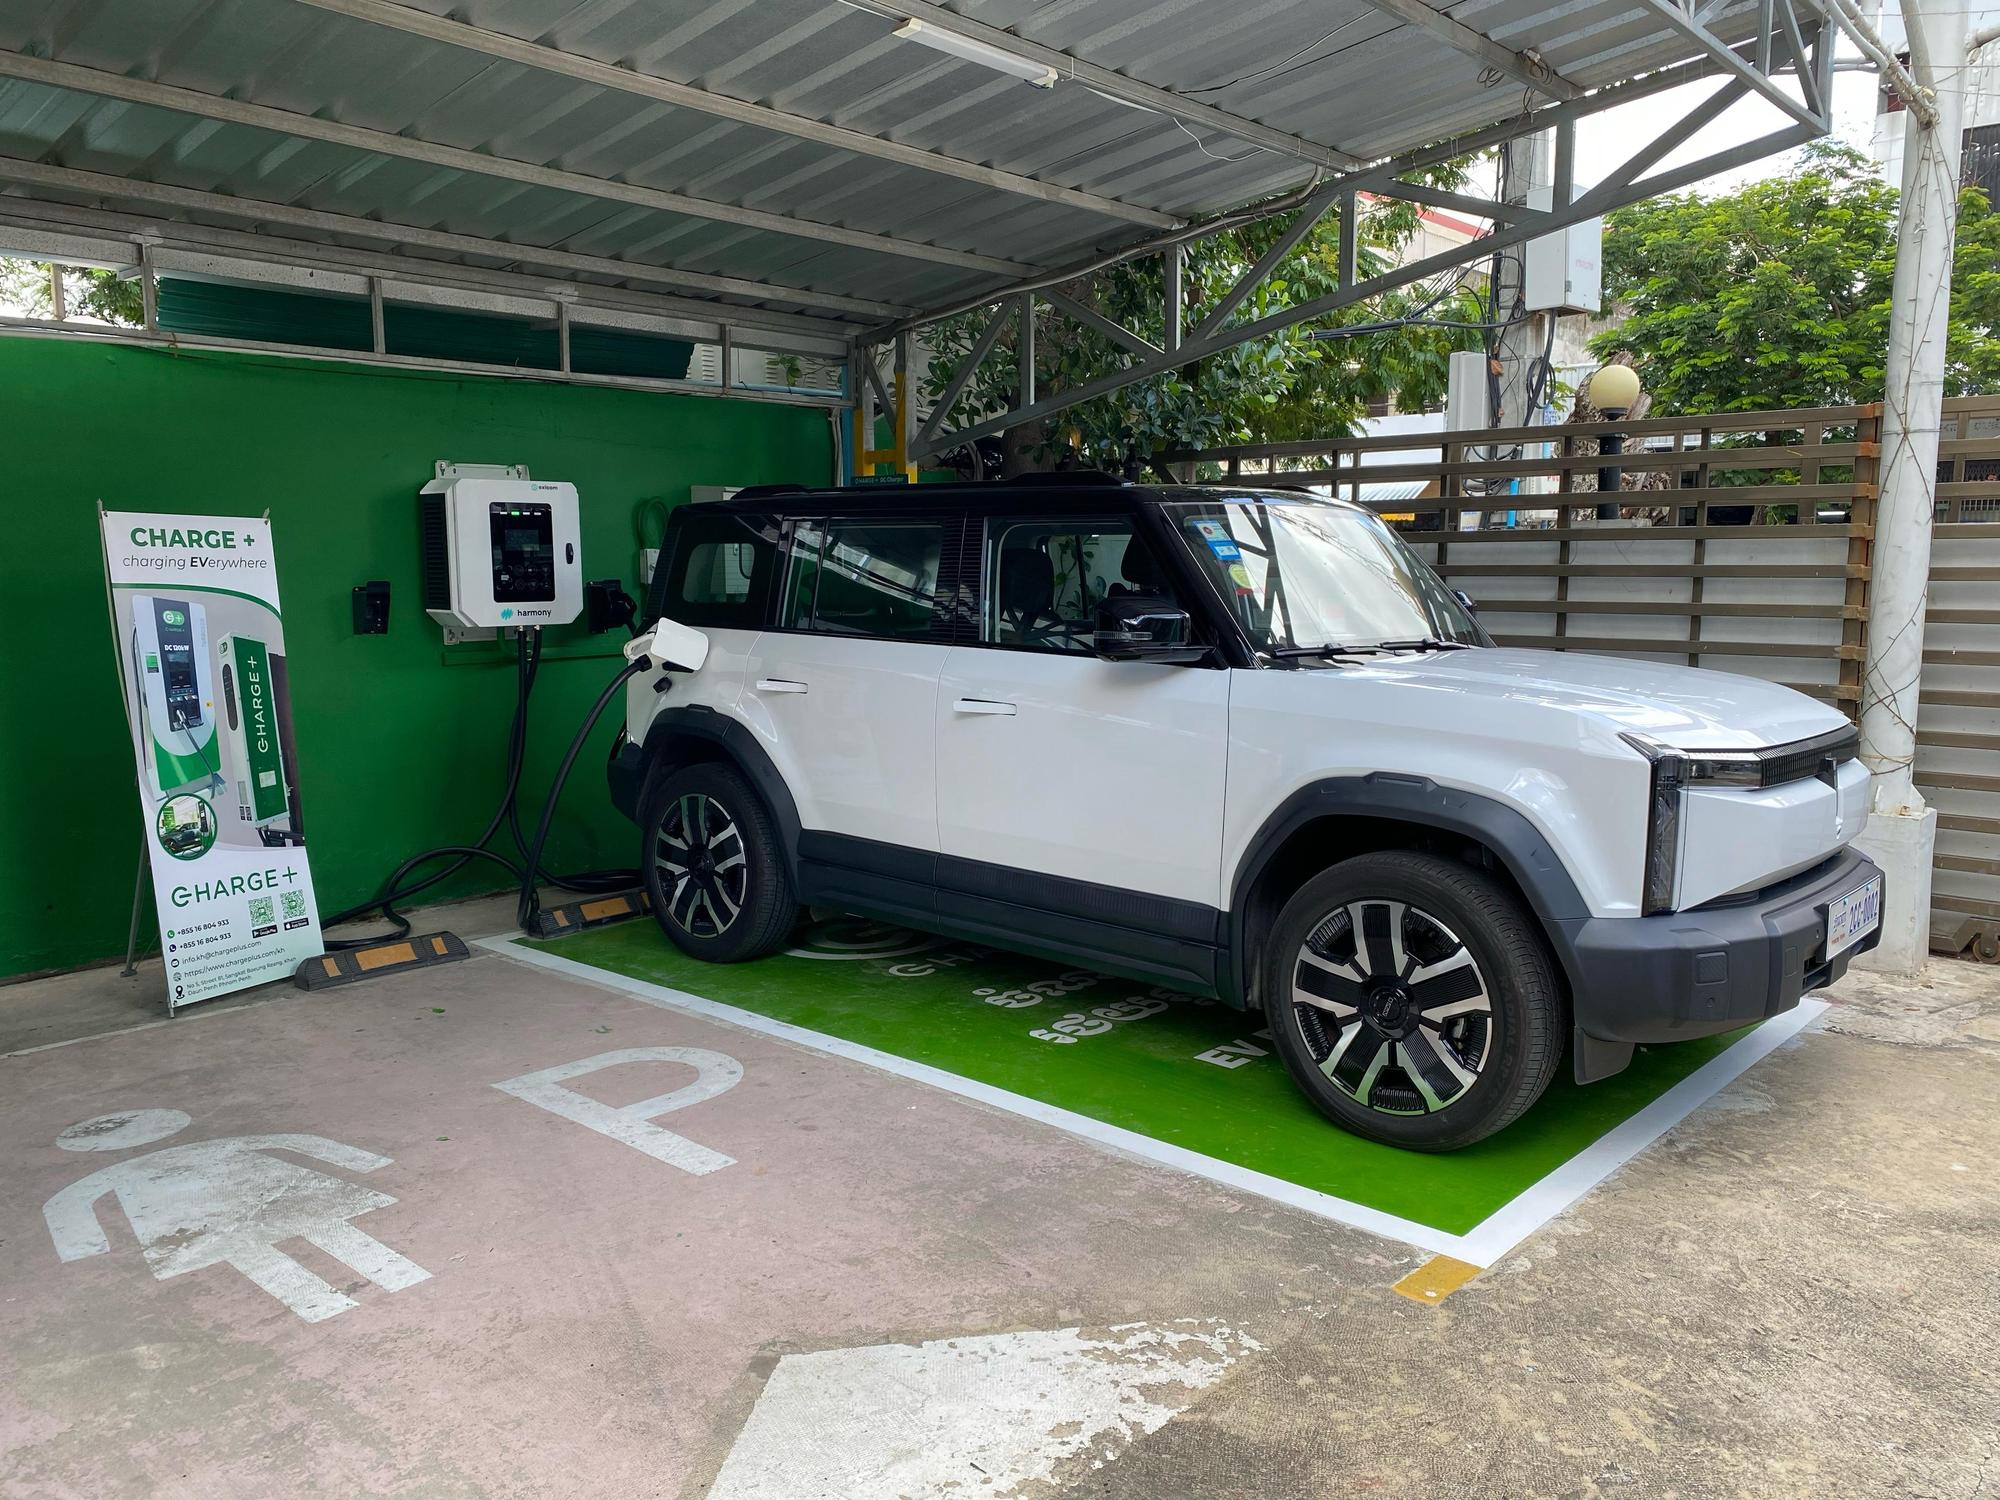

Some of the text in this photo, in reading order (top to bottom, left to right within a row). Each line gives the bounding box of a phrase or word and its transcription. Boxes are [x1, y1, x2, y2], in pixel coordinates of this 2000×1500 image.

[130, 527, 237, 549] CHARGE
[122, 554, 268, 571] charging EVerywhere
[517, 608, 552, 617] harmony
[177, 926, 194, 935] +855
[203, 922, 217, 930] 804
[217, 919, 230, 927] 933
[180, 932, 232, 949] +855 16 804 933
[182, 941, 262, 965] info.kh@chargeplus.com
[184, 947, 286, 978] https://www.chargeplus.com/kh
[1193, 1039, 1270, 1069] EV
[490, 1046, 744, 1176] P
